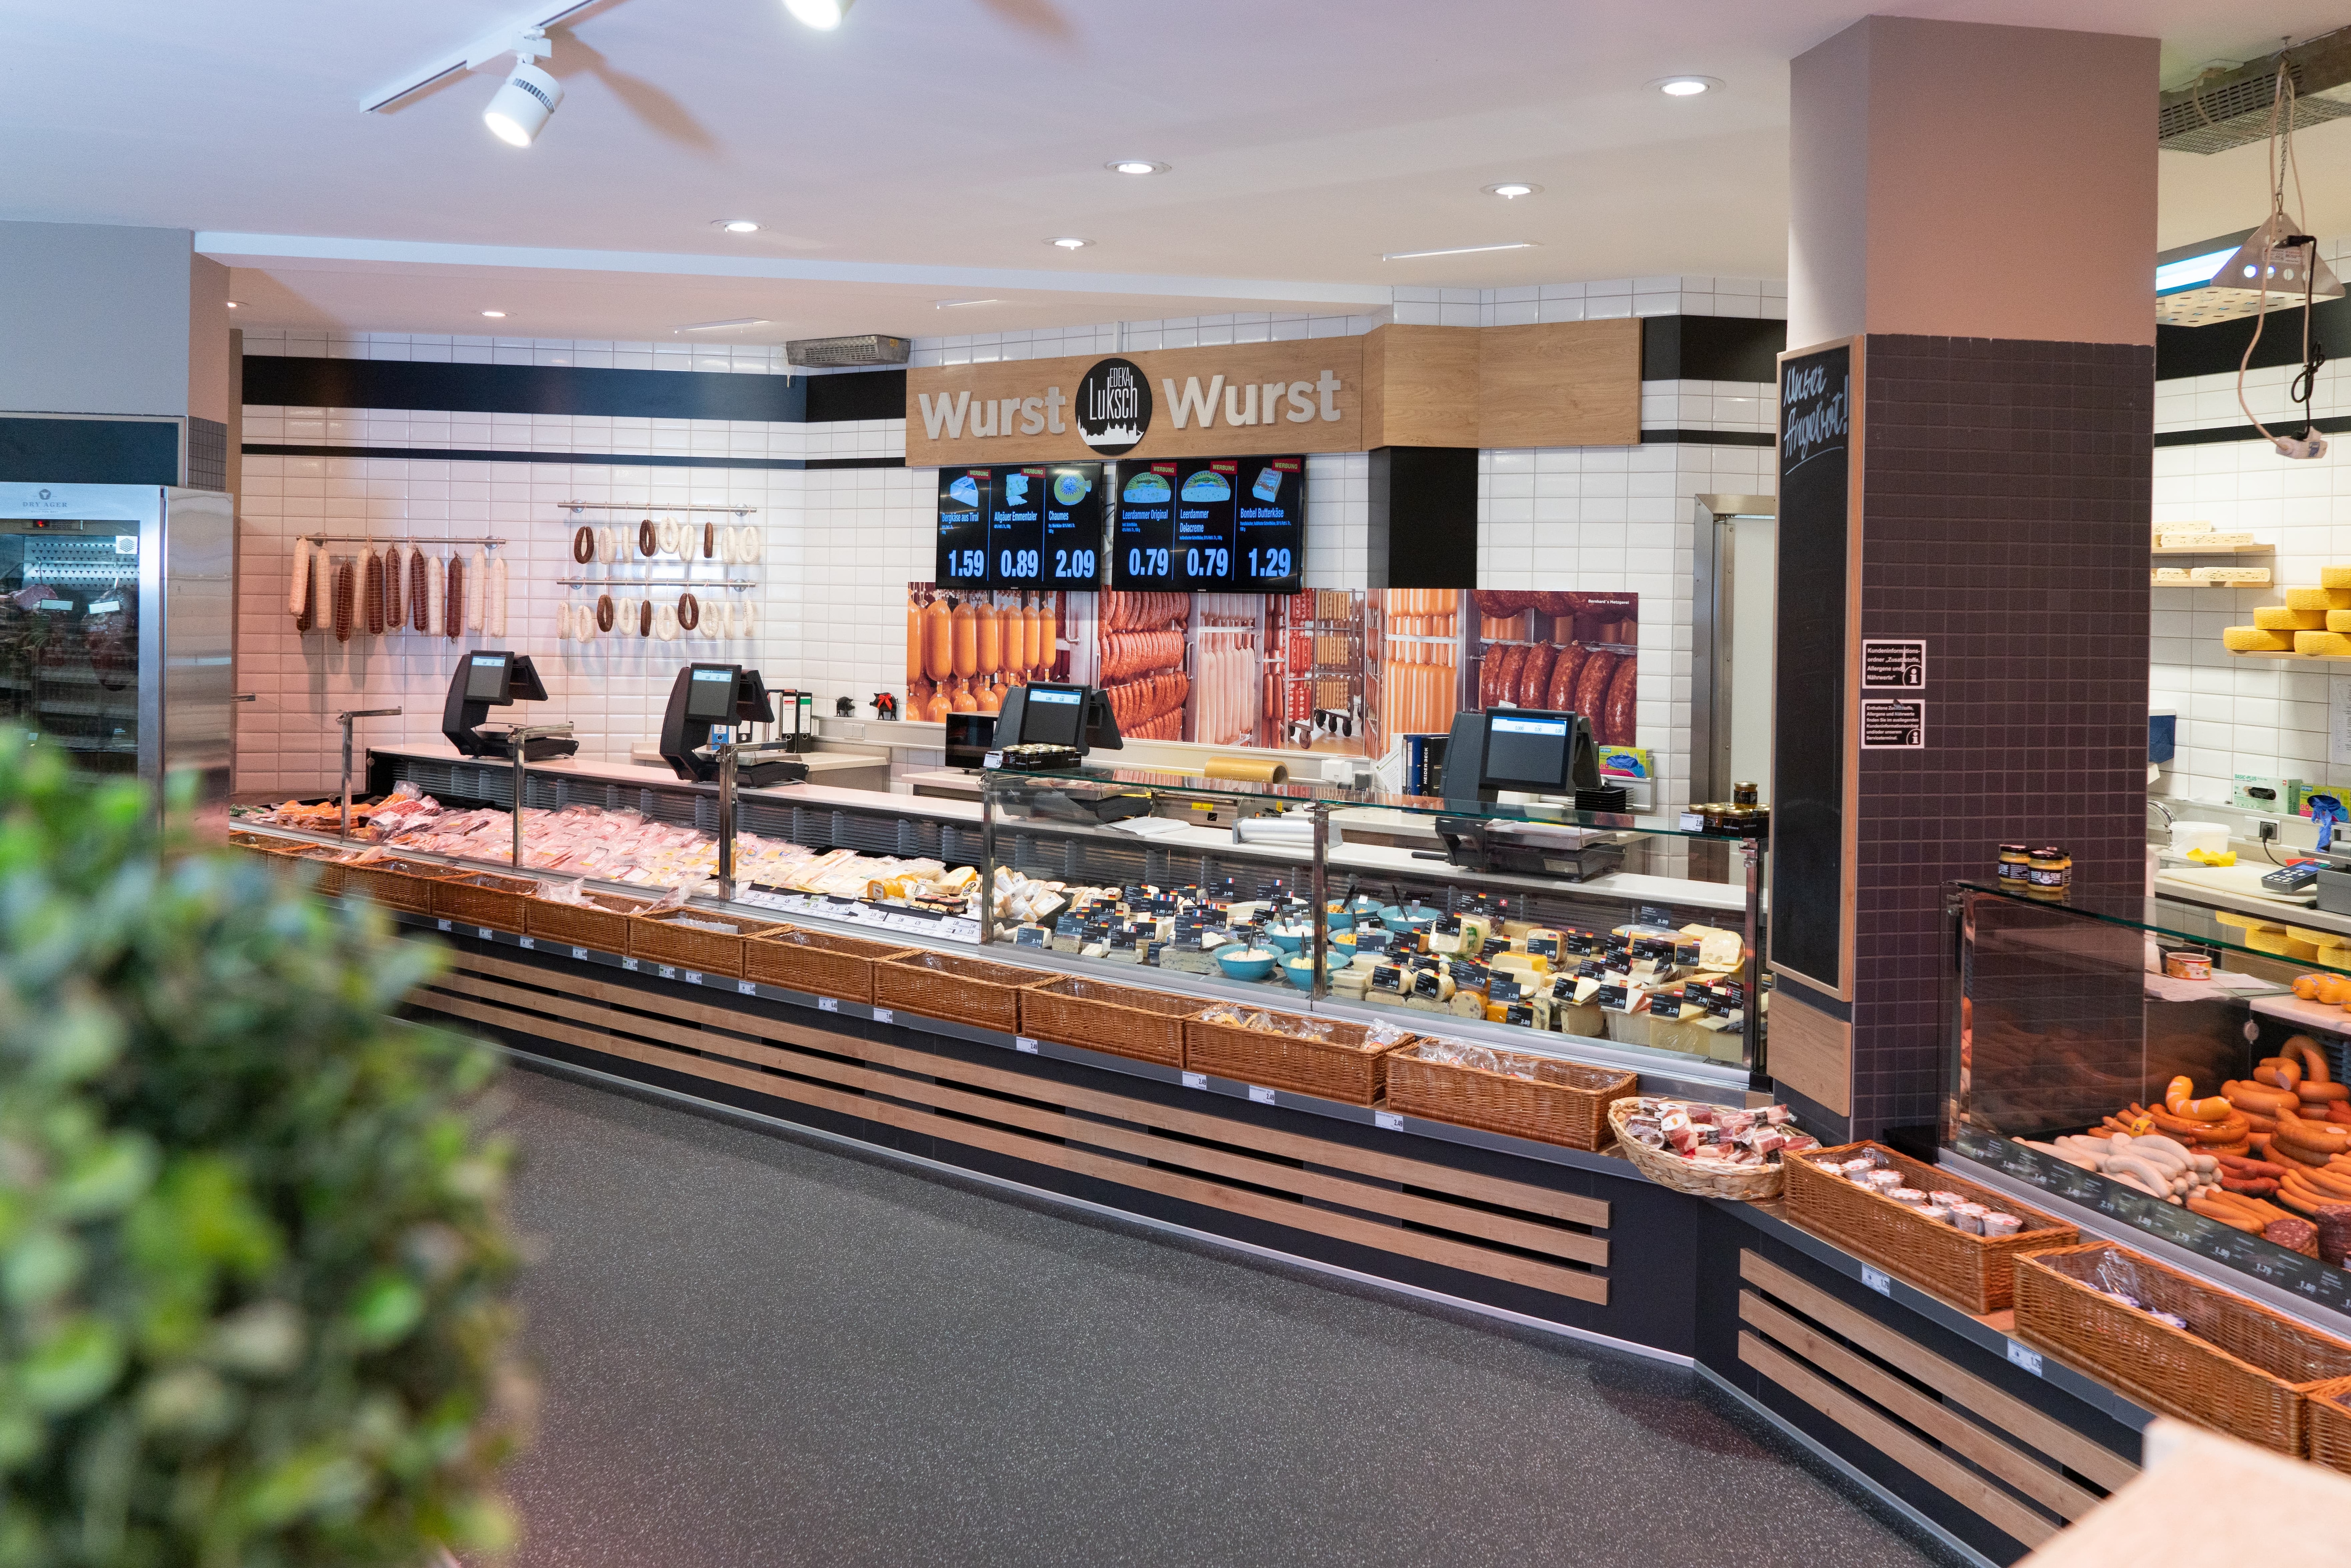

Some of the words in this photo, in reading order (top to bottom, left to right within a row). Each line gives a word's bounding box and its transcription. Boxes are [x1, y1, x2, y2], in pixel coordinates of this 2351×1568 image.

[1110, 367, 1130, 387] EDEKA
[1783, 365, 1827, 407] Unser
[1090, 375, 1138, 420] Luksch
[1162, 370, 1341, 429] Wurst
[918, 386, 1065, 440] Wurst
[1784, 374, 1849, 460] Angebot!
[941, 512, 961, 524] Bergkäse
[970, 512, 979, 522] Tirol
[994, 512, 1012, 523] Allgäuer
[1012, 512, 1037, 521] Emmentaler
[1049, 511, 1069, 521] Chaumes
[1123, 510, 1150, 519] Leerdammer
[1151, 509, 1168, 521] Original
[1180, 509, 1209, 519] Leerdammer
[1240, 508, 1256, 518] Bonbel
[1258, 508, 1284, 518] Butterkäse
[1180, 523, 1204, 532] Delacreme
[949, 550, 985, 577] 1.59
[1001, 549, 1038, 577] 0.89
[1055, 549, 1095, 578] 2.09
[1129, 548, 1169, 576] 0.79
[1187, 548, 1228, 576] 0.79
[1249, 547, 1291, 577] 1.29
[1394, 1119, 1403, 1127] 2.49
[1881, 1278, 1889, 1290] 1.79
[2030, 1356, 2042, 1369] 1.79
